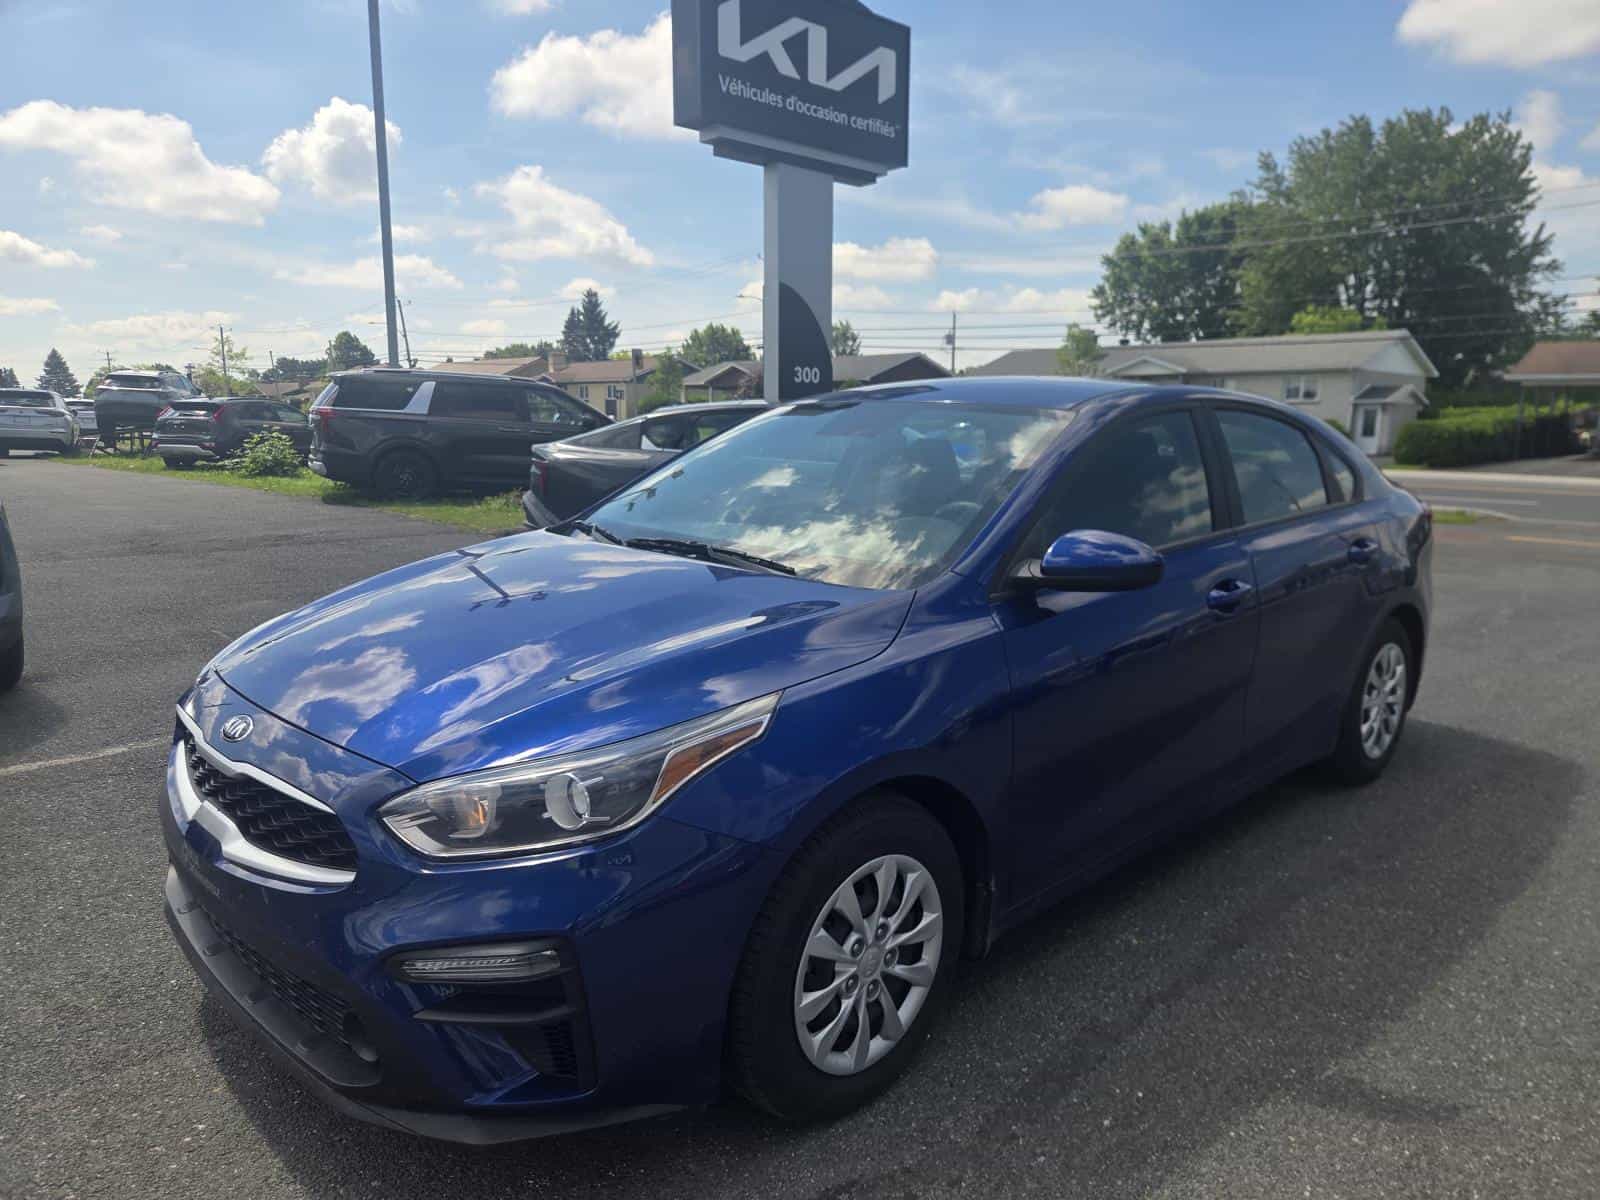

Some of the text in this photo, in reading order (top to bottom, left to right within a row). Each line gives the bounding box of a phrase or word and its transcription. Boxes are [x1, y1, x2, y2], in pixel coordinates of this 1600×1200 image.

[718, 72, 895, 138] Véhicules d'occasion certifiés
[794, 366, 820, 384] 300
